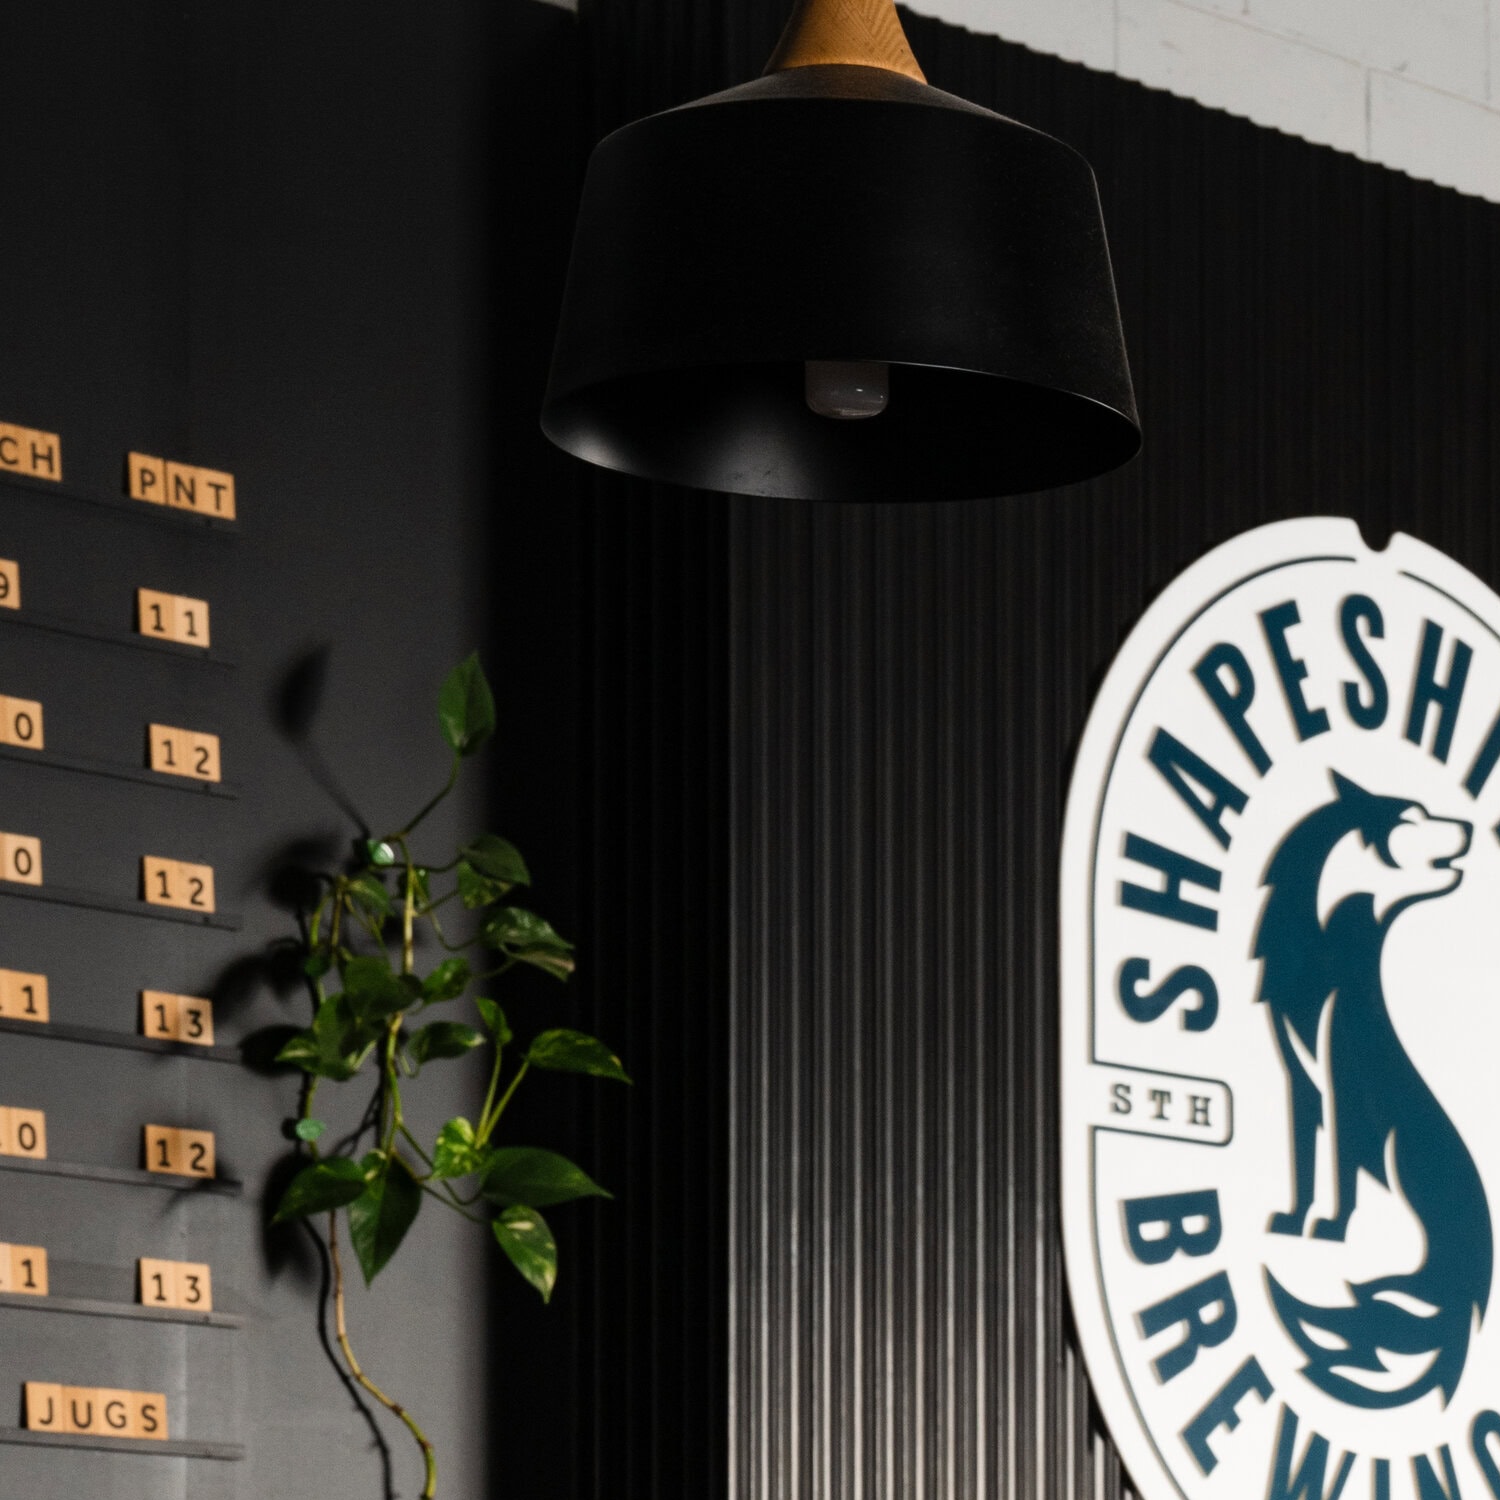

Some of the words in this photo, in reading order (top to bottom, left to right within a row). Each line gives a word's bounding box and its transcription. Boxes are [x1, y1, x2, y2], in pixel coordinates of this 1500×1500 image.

[140, 467, 228, 511] PNT
[151, 604, 198, 638] 11
[161, 739, 210, 775] 12
[157, 870, 205, 906] 12
[156, 1003, 204, 1038] 13
[1110, 1083, 1214, 1128] STH
[157, 1138, 206, 1172] 12
[152, 1272, 201, 1305] 13
[39, 1396, 158, 1433] JUGS
